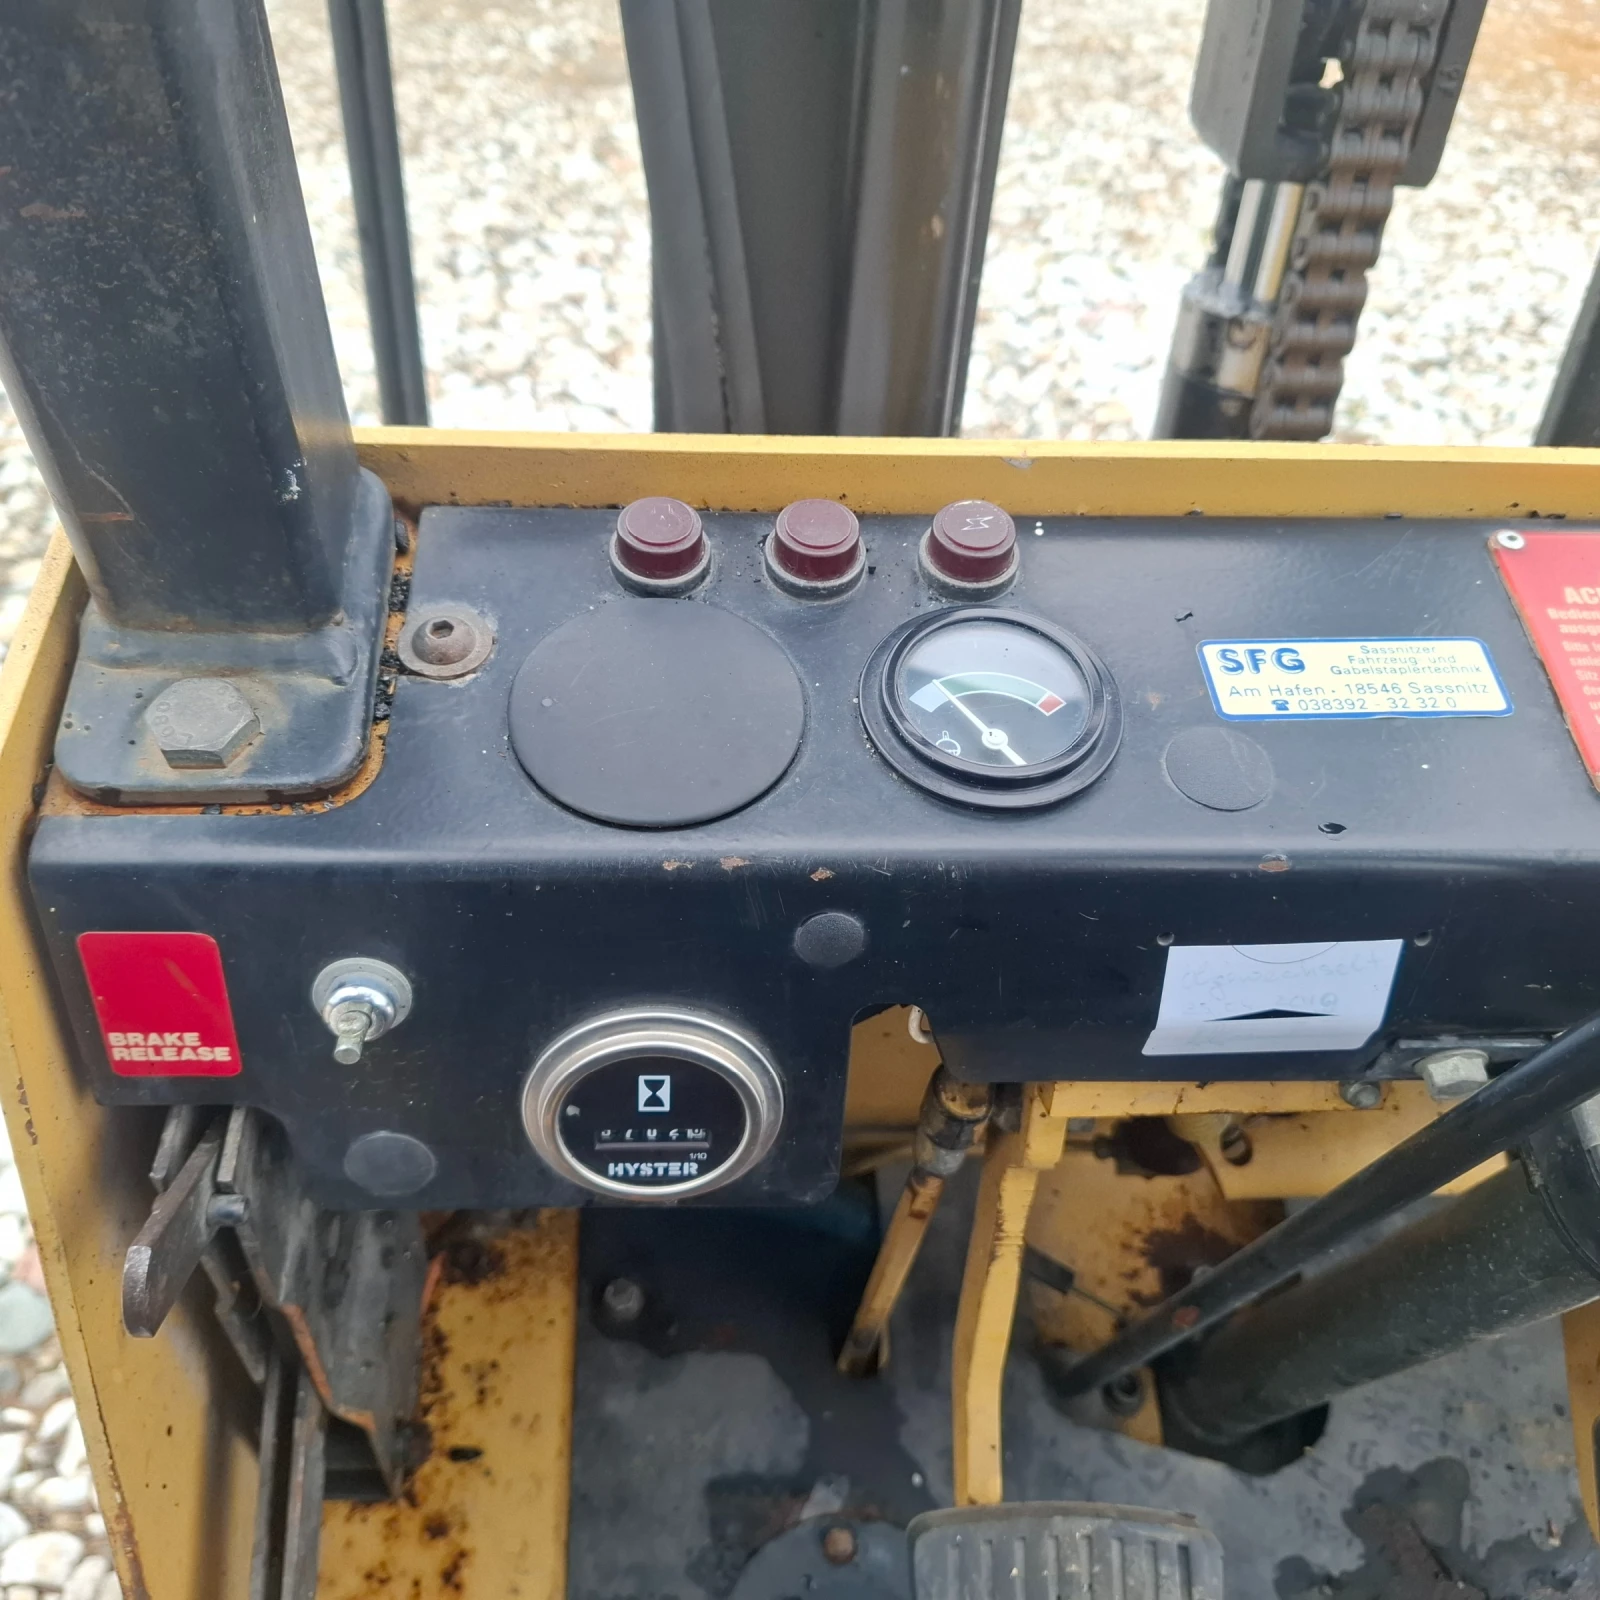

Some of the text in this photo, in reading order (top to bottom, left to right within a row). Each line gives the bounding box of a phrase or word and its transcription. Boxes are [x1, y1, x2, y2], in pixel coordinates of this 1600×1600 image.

[1360, 644, 1436, 655] Sassnitzer
[1216, 647, 1306, 675] SFG
[1428, 655, 1457, 664] und
[1330, 664, 1482, 676] Gabelstaplertechnik
[1229, 685, 1261, 697] Am
[1268, 684, 1325, 697] Hafen
[1345, 683, 1402, 695] 18546
[1408, 682, 1489, 694] Sassnitz
[1298, 698, 1368, 711] 038392
[1386, 697, 1410, 709] 32
[1415, 697, 1440, 709] 32
[1446, 696, 1457, 708] 0
[107, 1031, 201, 1047] BRAKE
[111, 1046, 232, 1062] RELEASE
[607, 1162, 699, 1177] HYSTER
